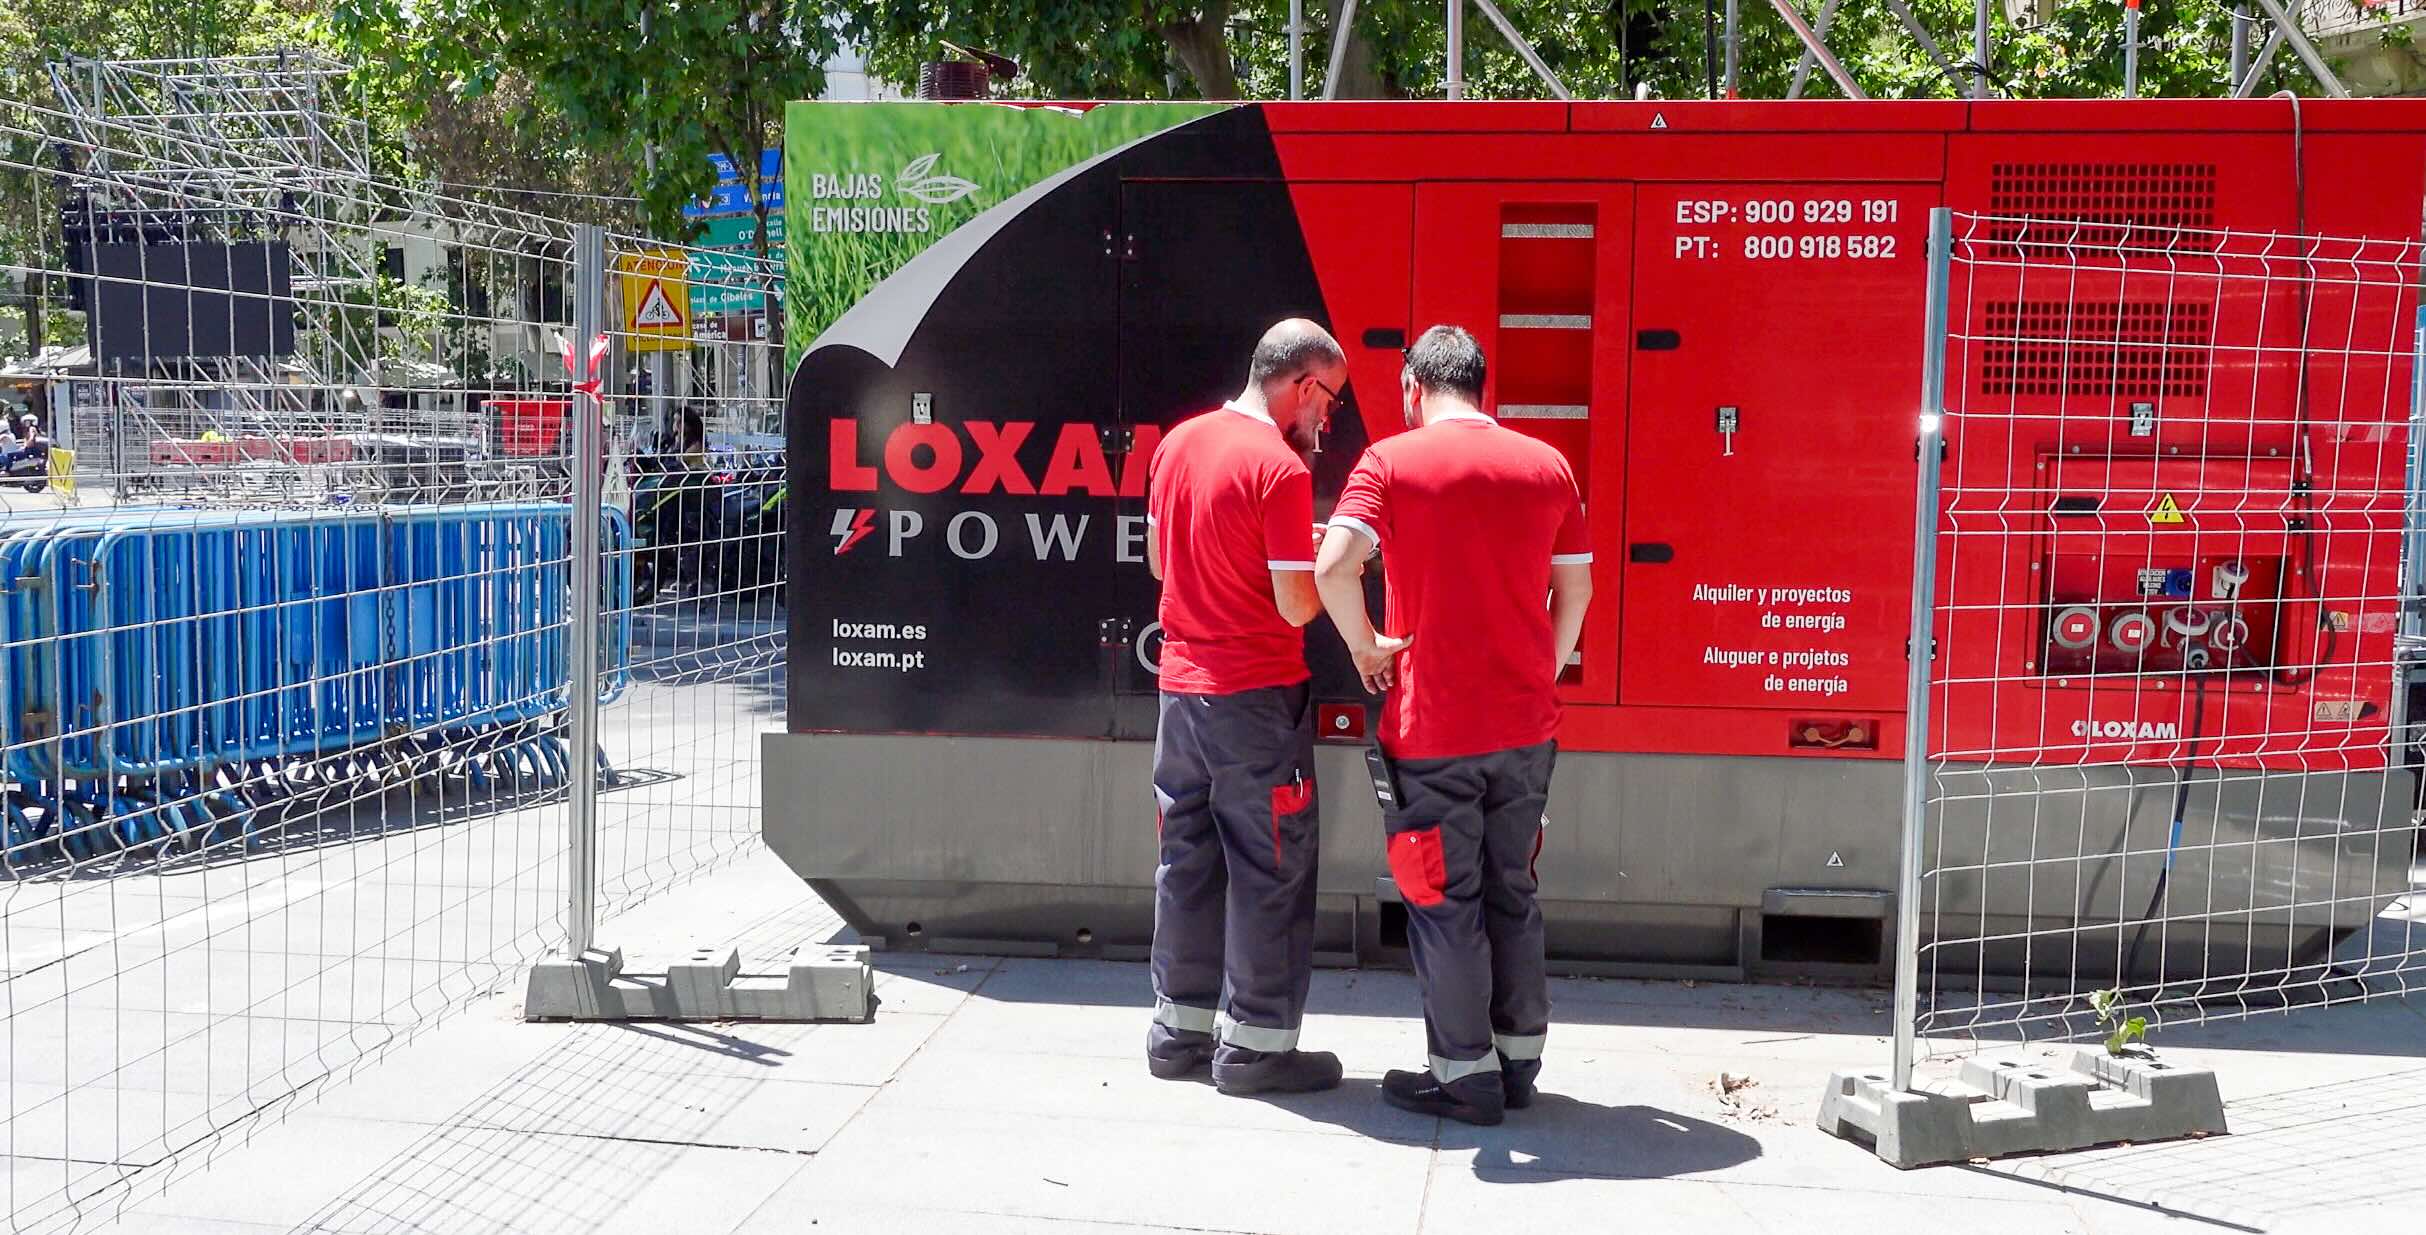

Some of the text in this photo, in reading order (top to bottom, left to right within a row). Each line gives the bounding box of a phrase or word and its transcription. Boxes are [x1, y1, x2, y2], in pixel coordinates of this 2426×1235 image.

[812, 173, 882, 199] BAJAS
[812, 207, 929, 233] EMISIONES
[1676, 199, 1897, 224] ESP: 900 929 191
[1675, 235, 1896, 259] PT: 800 918 582
[721, 291, 753, 302] Cibeles
[693, 329, 726, 340] América
[709, 321, 718, 329] de
[1692, 583, 1851, 606] Alquiler y proyectos
[832, 618, 927, 641] loxam.es
[1761, 610, 1845, 633] de energía
[832, 646, 925, 672] loxam.pt
[1703, 646, 1849, 670] Aluguer e projetos
[1764, 674, 1848, 696] de energía
[2091, 720, 2178, 739] LOXAM
